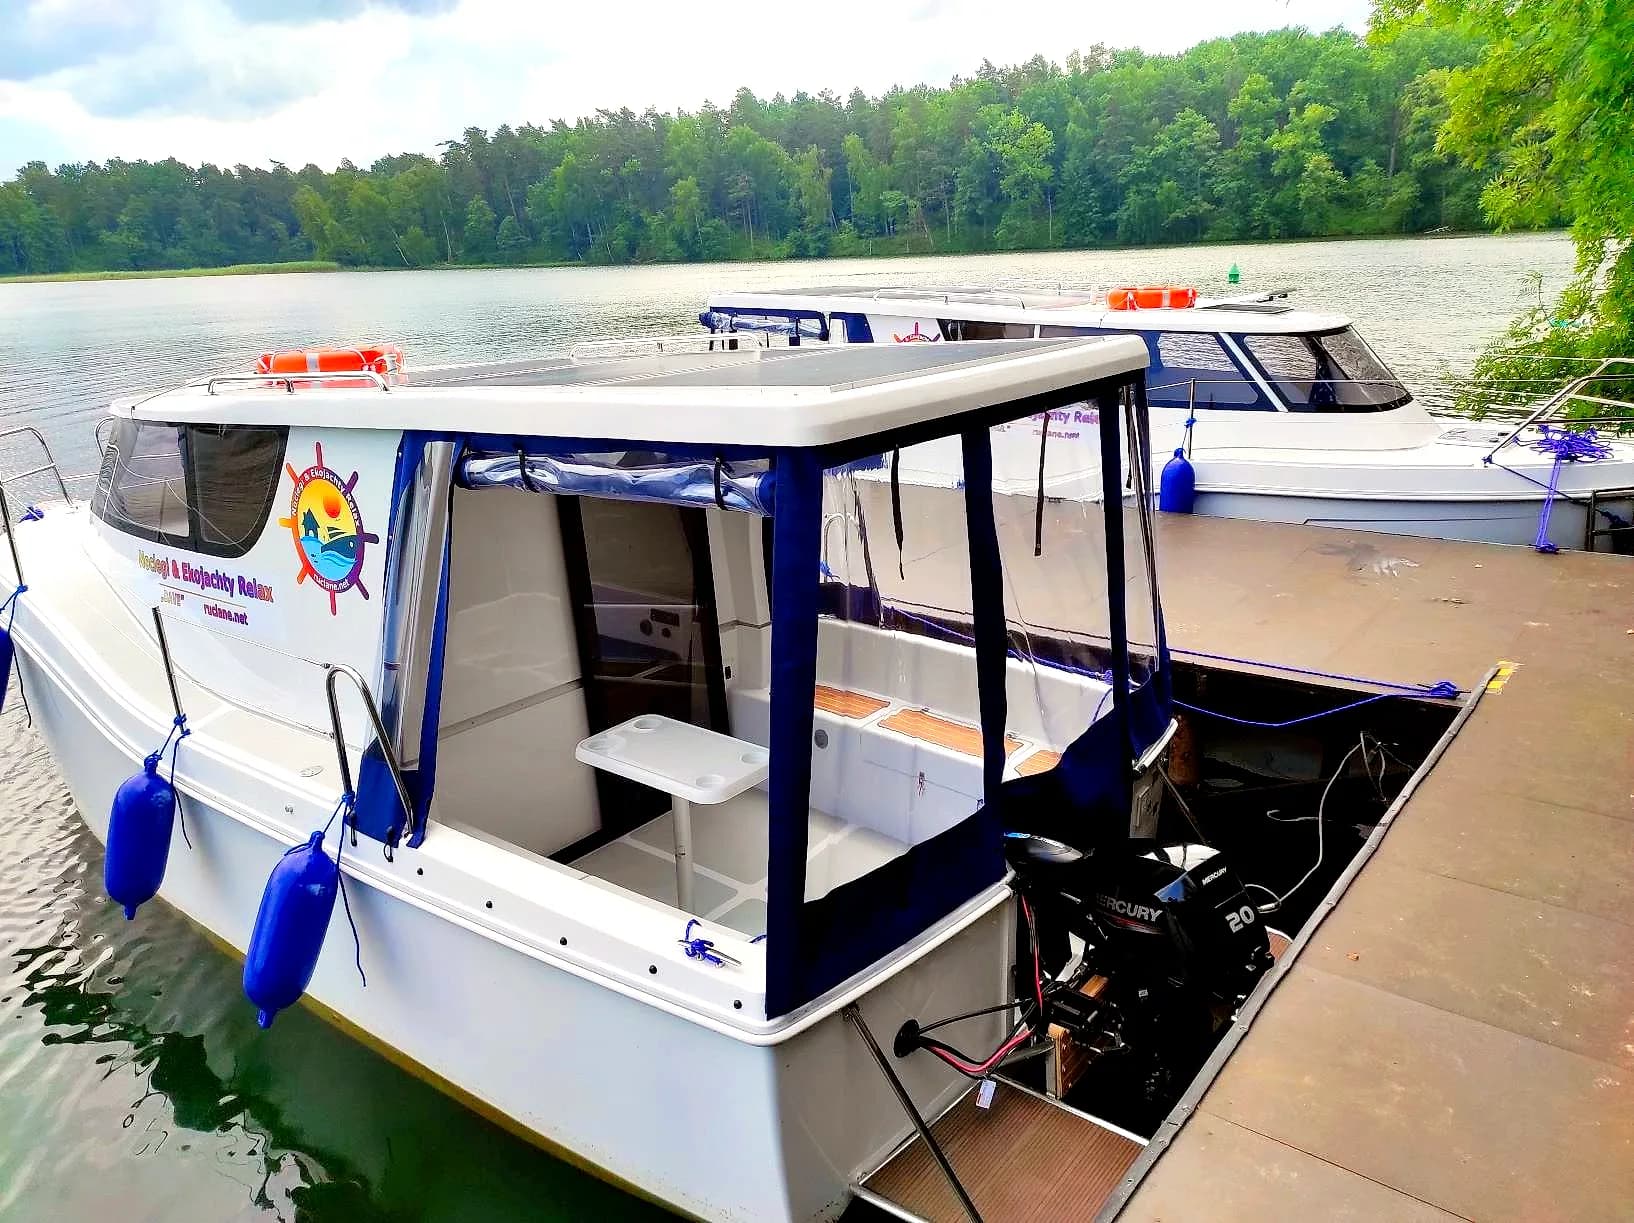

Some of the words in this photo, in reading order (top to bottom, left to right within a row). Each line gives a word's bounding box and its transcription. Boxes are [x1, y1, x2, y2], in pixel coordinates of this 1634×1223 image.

[345, 492, 361, 527] Relax
[171, 559, 181, 579] &
[181, 561, 235, 597] Ekojachty
[237, 575, 274, 603] Relax
[1201, 866, 1227, 886] MERCURY
[1225, 905, 1255, 934] 20
